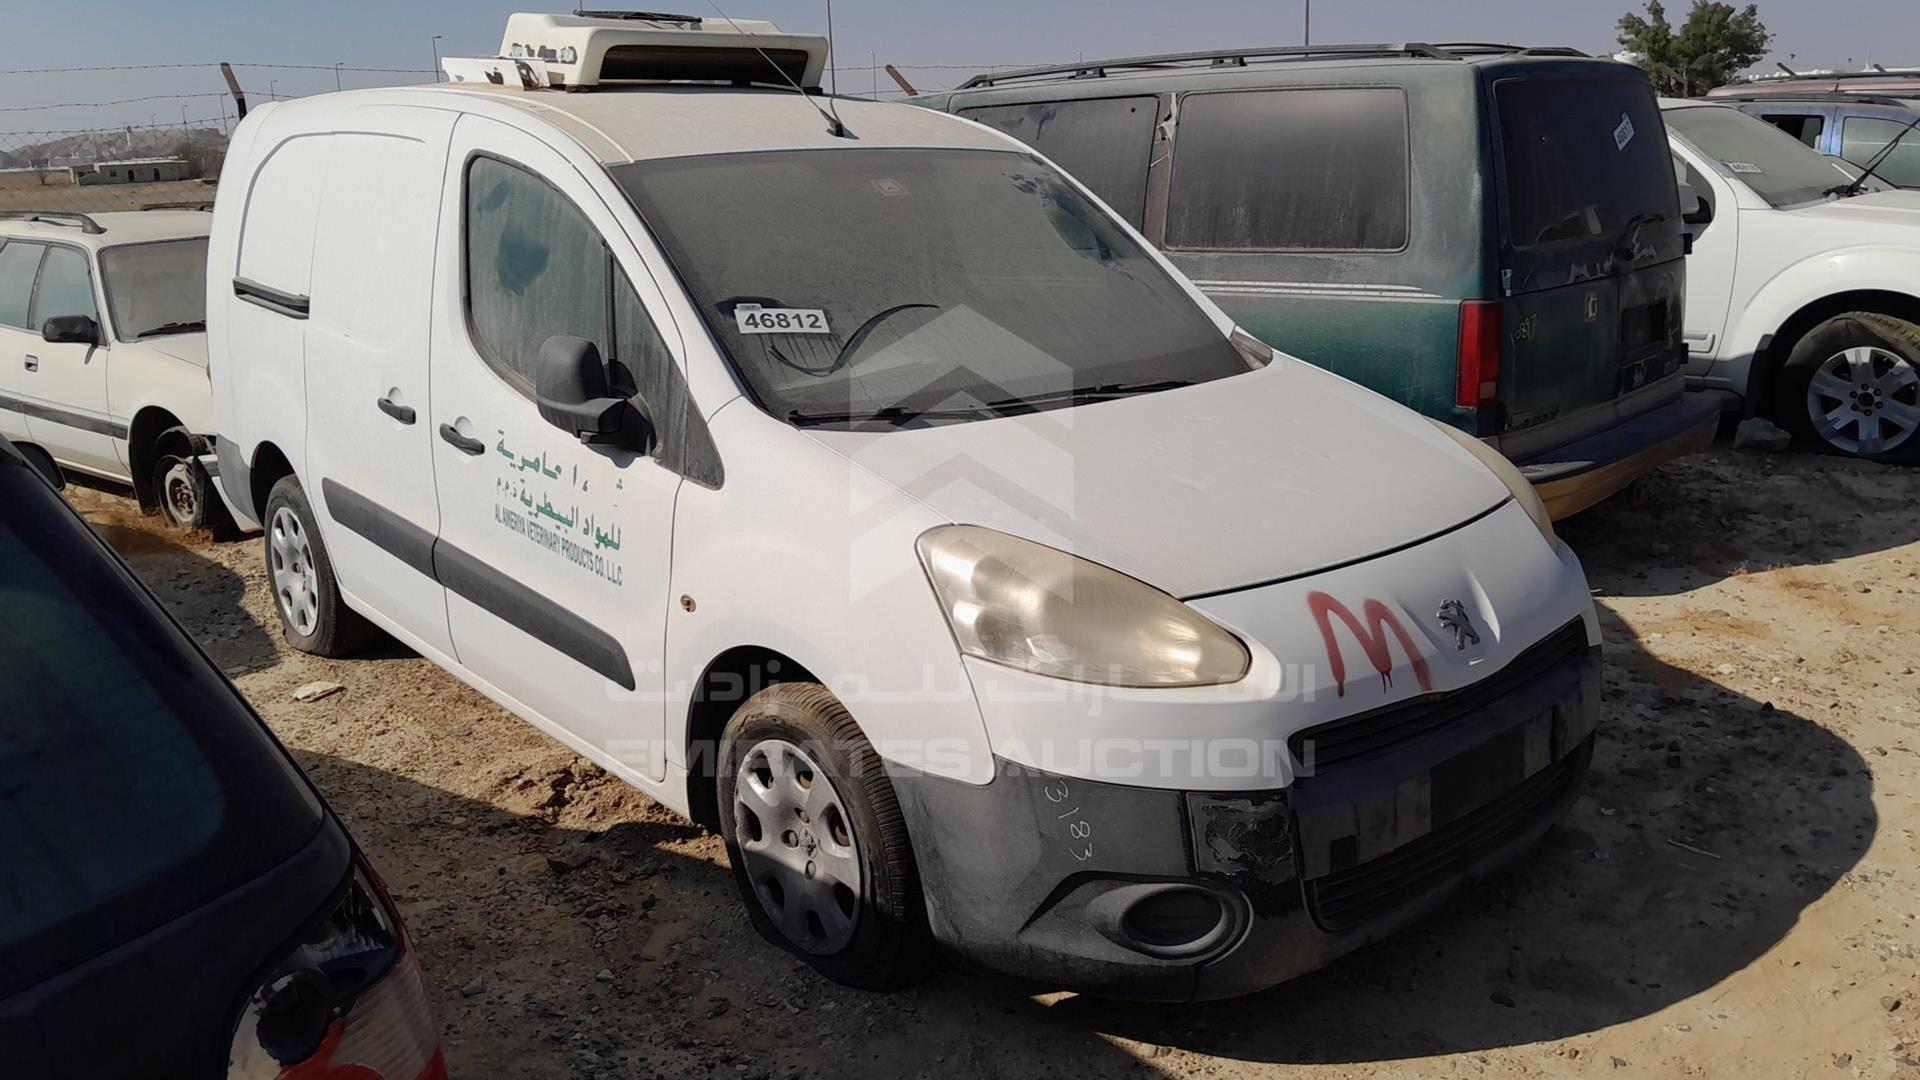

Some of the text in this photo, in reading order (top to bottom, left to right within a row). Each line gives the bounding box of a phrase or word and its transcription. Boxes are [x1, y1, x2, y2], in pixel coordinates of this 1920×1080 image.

[744, 312, 823, 329] 46812
[495, 502, 502, 524] AL
[527, 519, 561, 556] VETERINARY
[561, 537, 594, 572] PRODUCTS
